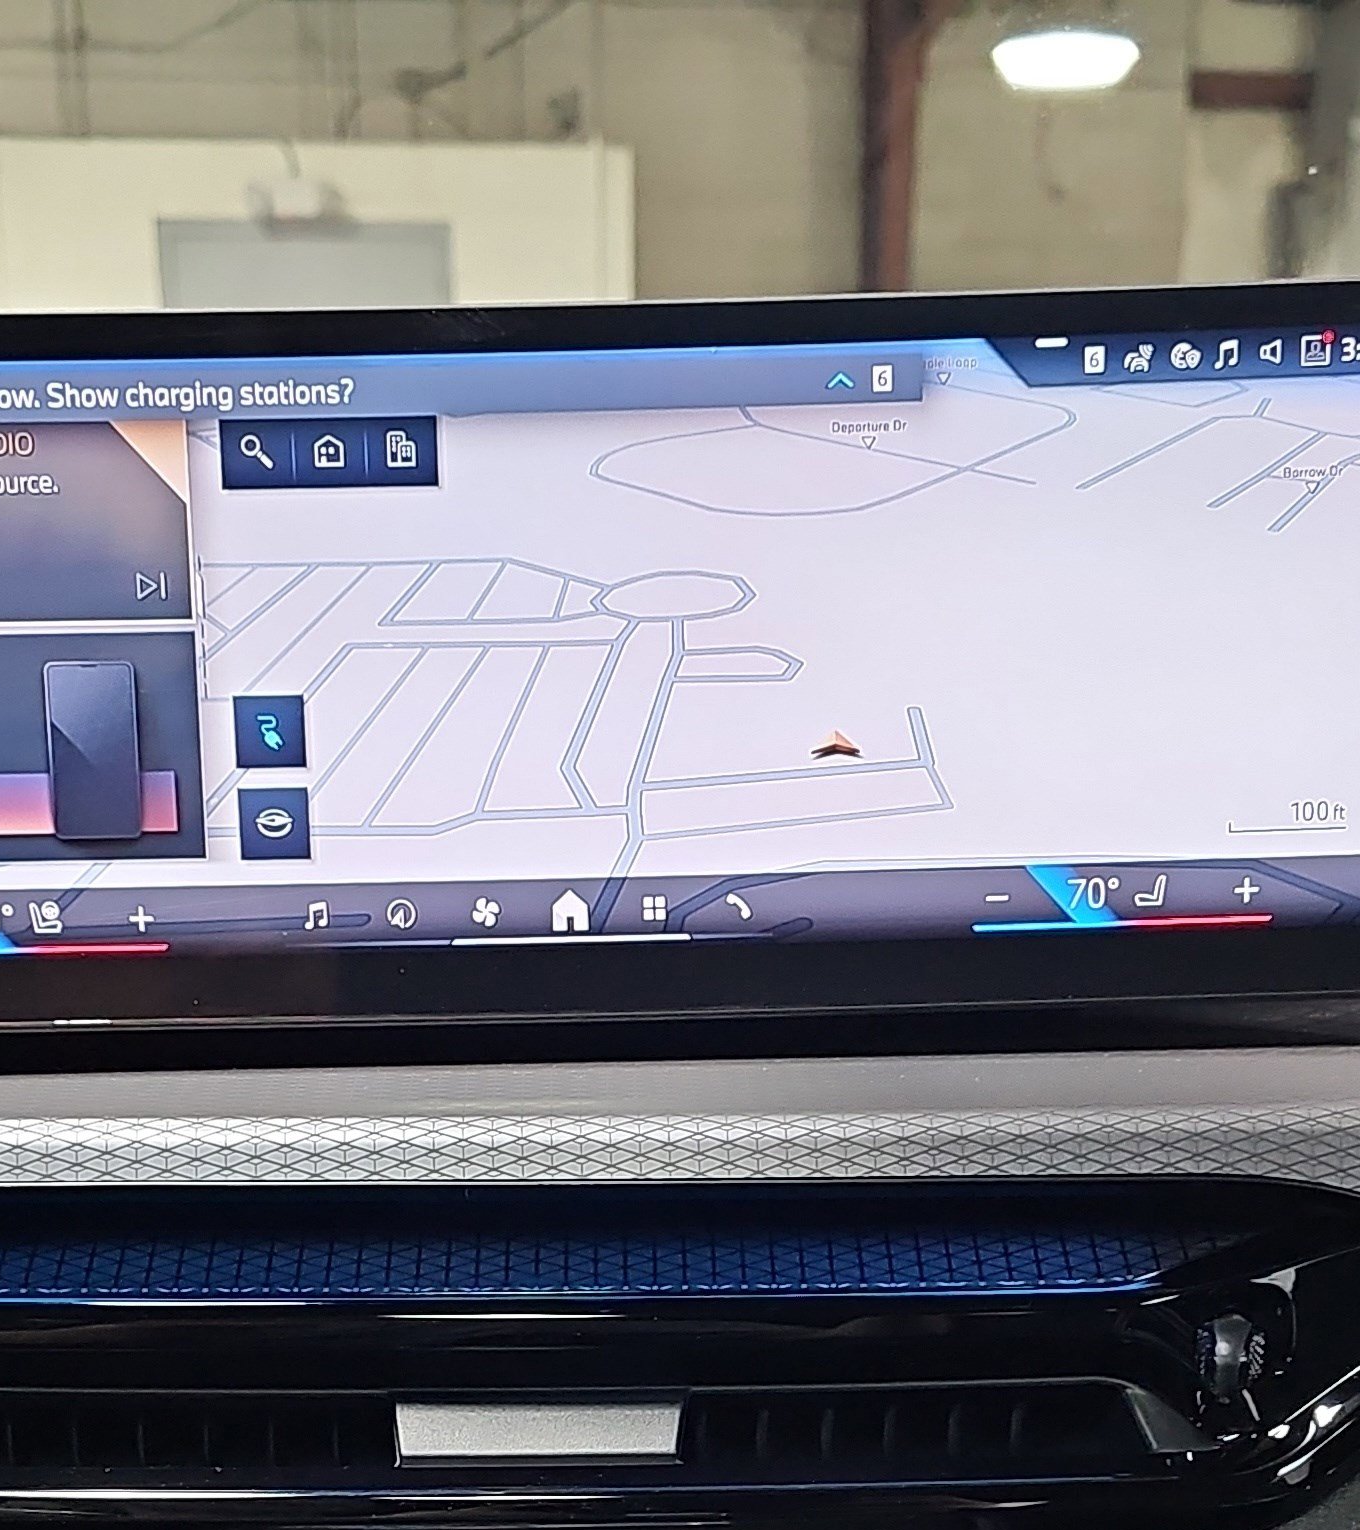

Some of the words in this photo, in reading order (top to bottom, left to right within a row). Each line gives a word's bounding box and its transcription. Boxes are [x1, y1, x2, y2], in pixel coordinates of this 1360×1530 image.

[46, 381, 118, 409] Show
[125, 381, 234, 412] charging
[239, 378, 355, 406] stations?
[831, 421, 890, 434] Departure
[893, 419, 907, 431] Dr
[1291, 801, 1329, 821] 100
[1333, 803, 1346, 821] ft
[1067, 877, 1121, 909] 70°
